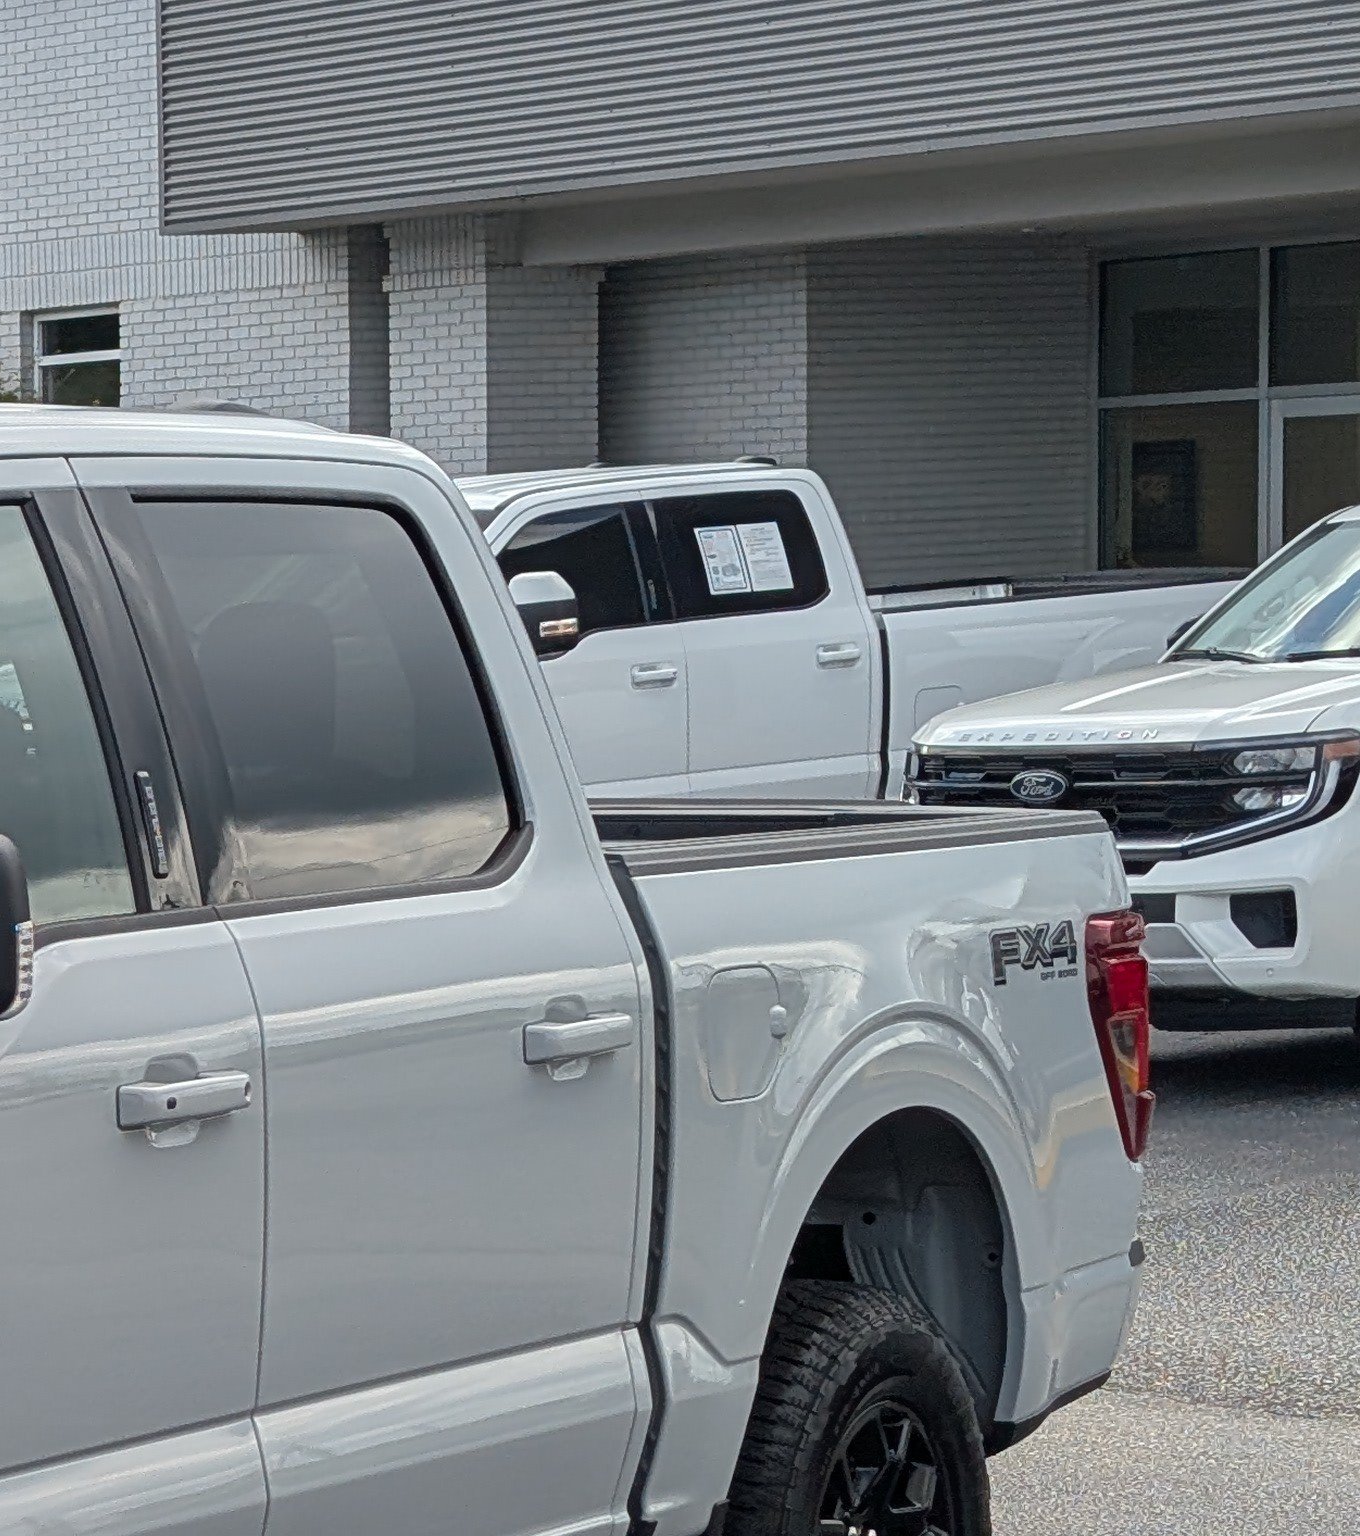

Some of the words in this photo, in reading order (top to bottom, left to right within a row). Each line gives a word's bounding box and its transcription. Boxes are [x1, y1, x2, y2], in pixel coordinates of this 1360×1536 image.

[958, 728, 1159, 742] EXPEDITION
[1020, 777, 1055, 796] Ford
[988, 919, 1078, 987] FX4
